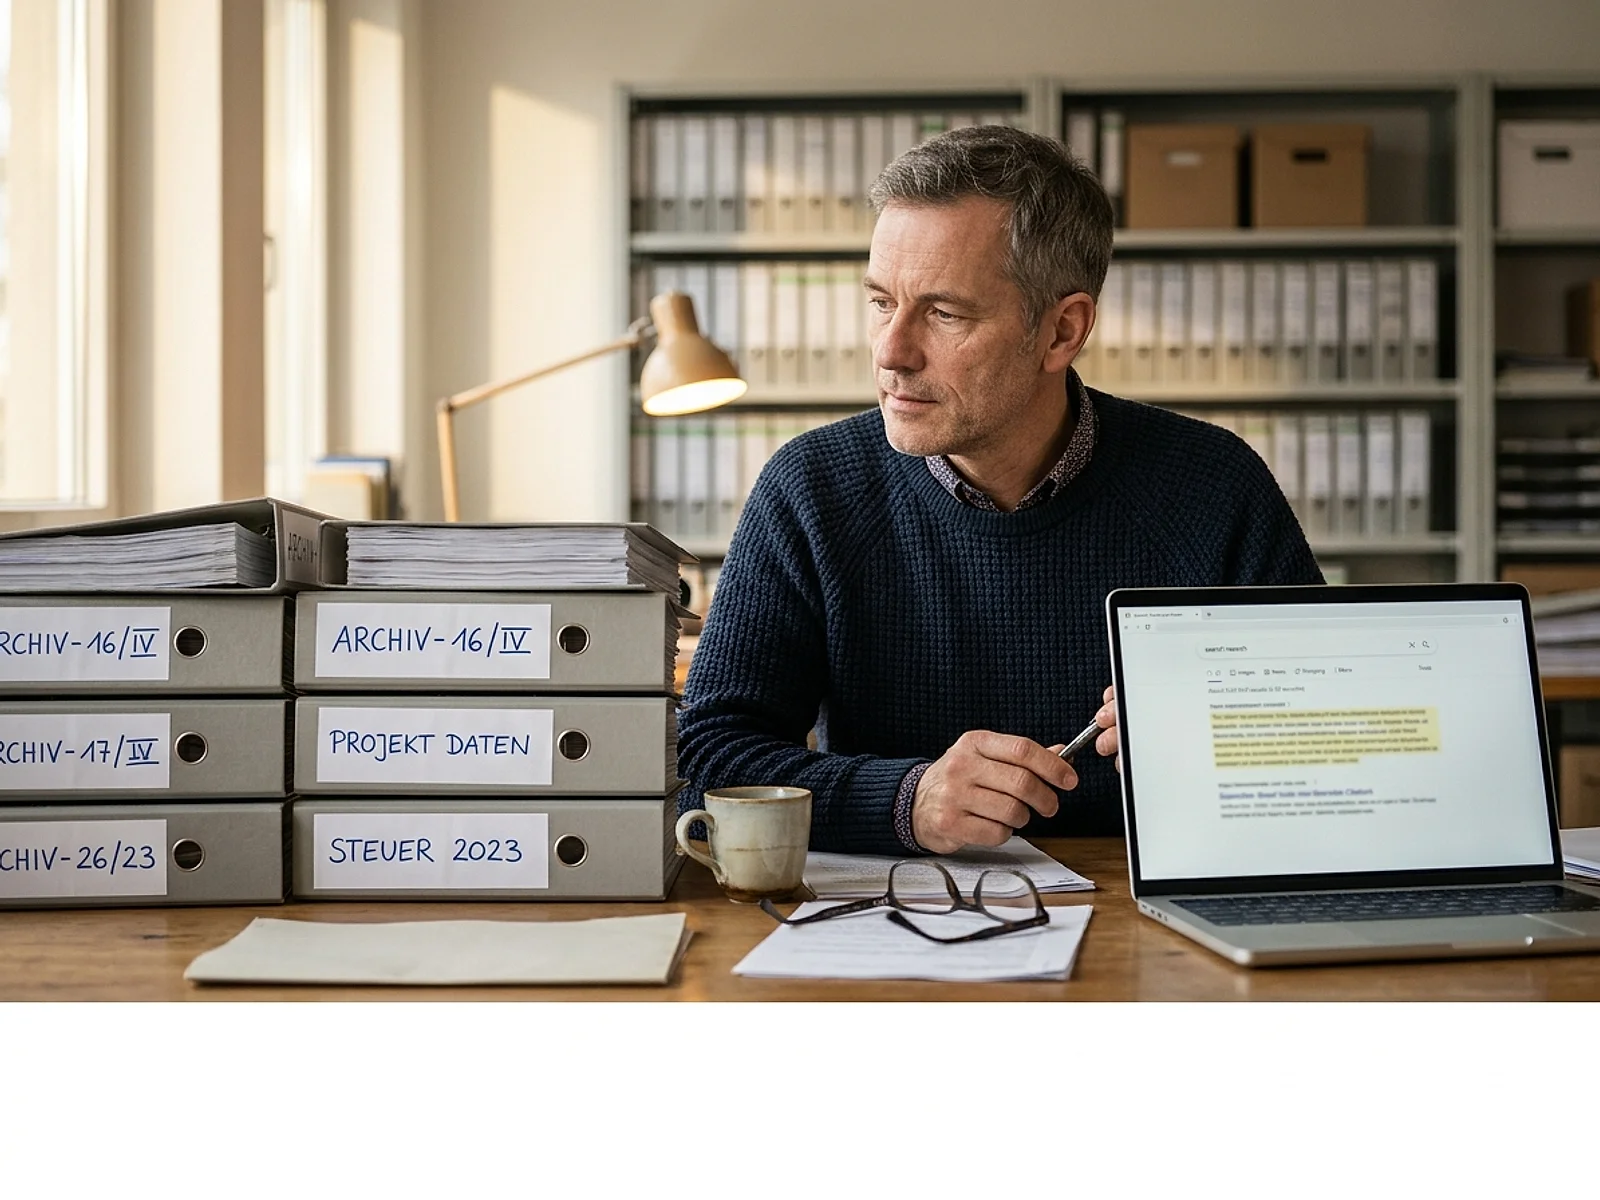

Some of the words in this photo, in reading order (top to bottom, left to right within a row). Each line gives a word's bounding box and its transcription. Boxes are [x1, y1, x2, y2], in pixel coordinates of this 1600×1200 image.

[329, 729, 436, 762] PROJEKT
[445, 733, 530, 756] DATEN
[328, 837, 435, 864] STEUER
[452, 838, 523, 863] 2023
